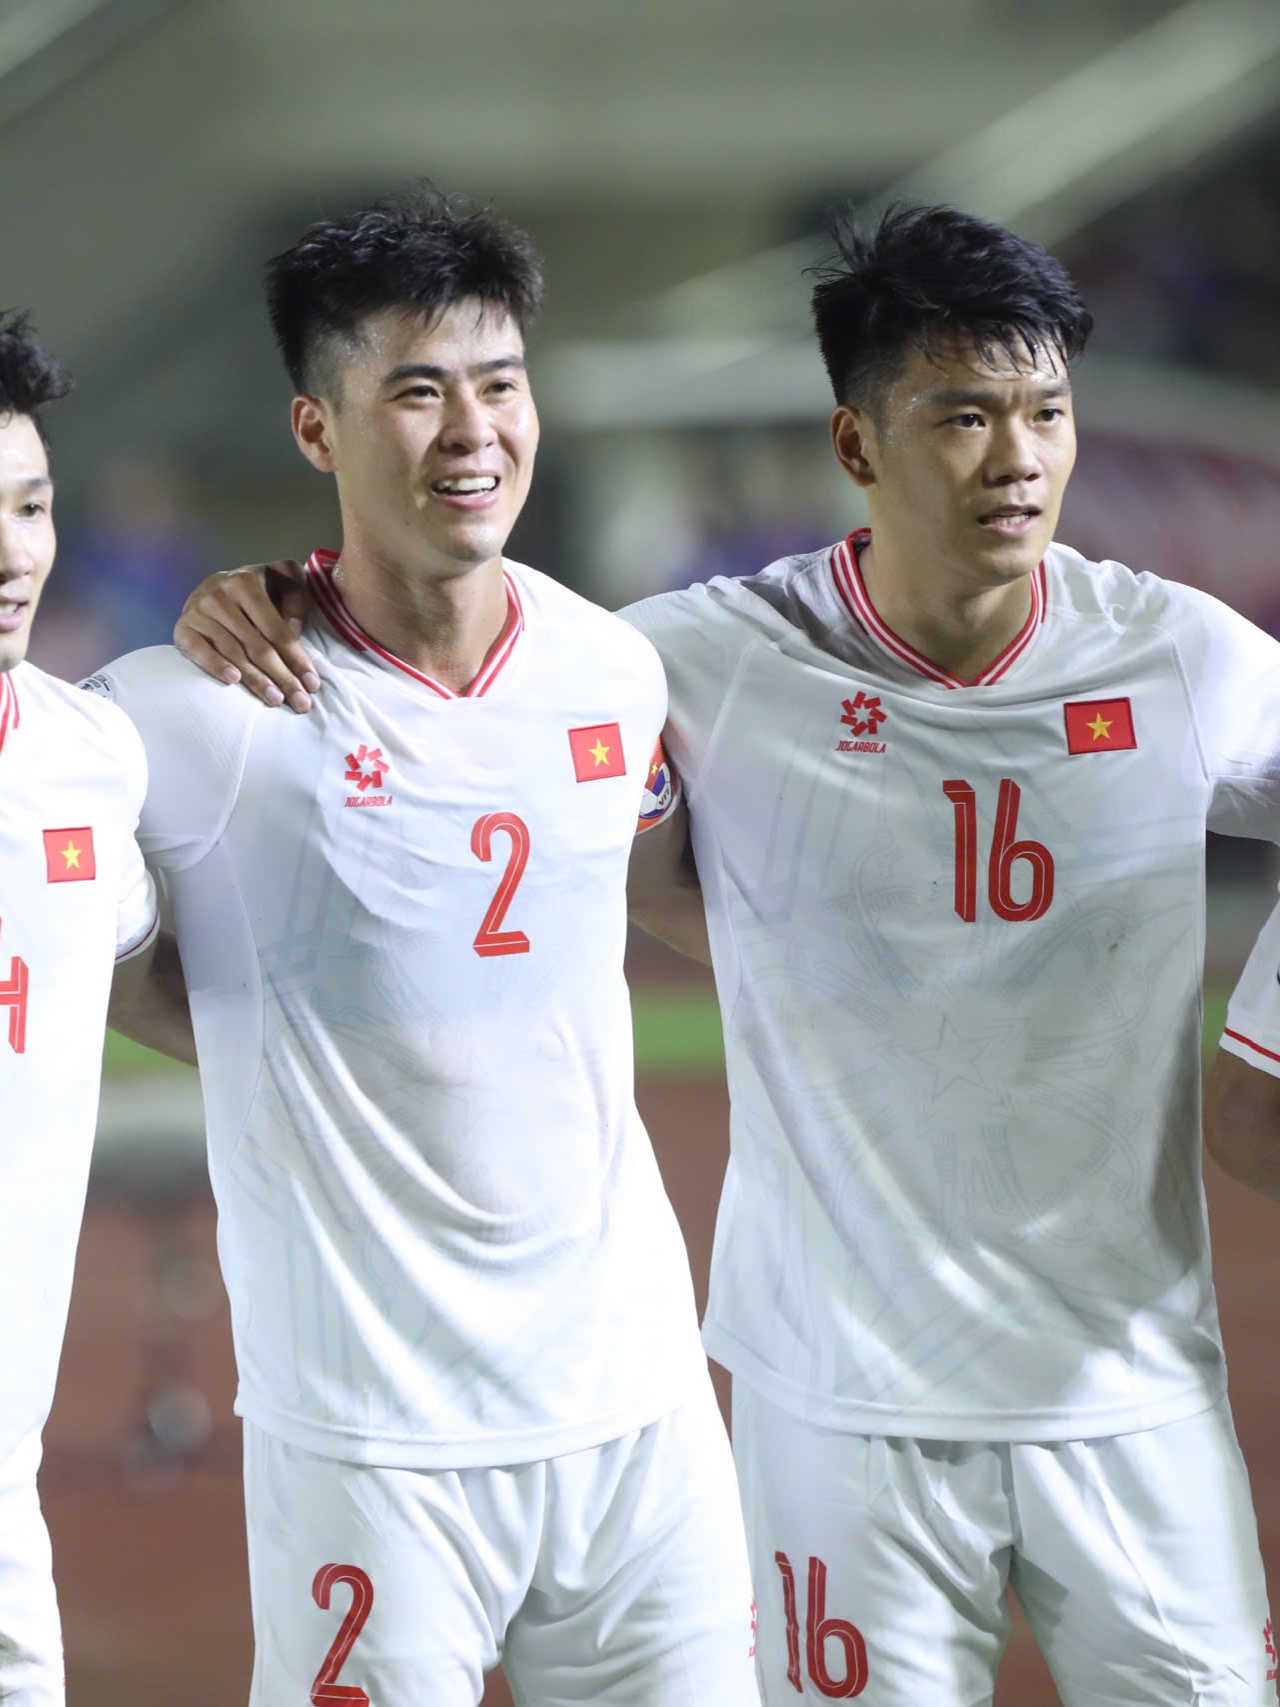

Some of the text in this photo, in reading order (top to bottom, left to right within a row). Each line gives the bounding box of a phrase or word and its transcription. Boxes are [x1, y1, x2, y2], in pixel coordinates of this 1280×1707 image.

[835, 740, 887, 753] JOGARBOLA
[471, 812, 530, 957] 2
[943, 779, 1054, 922] 16
[311, 1563, 373, 1707] 2
[775, 1551, 868, 1699] 16
